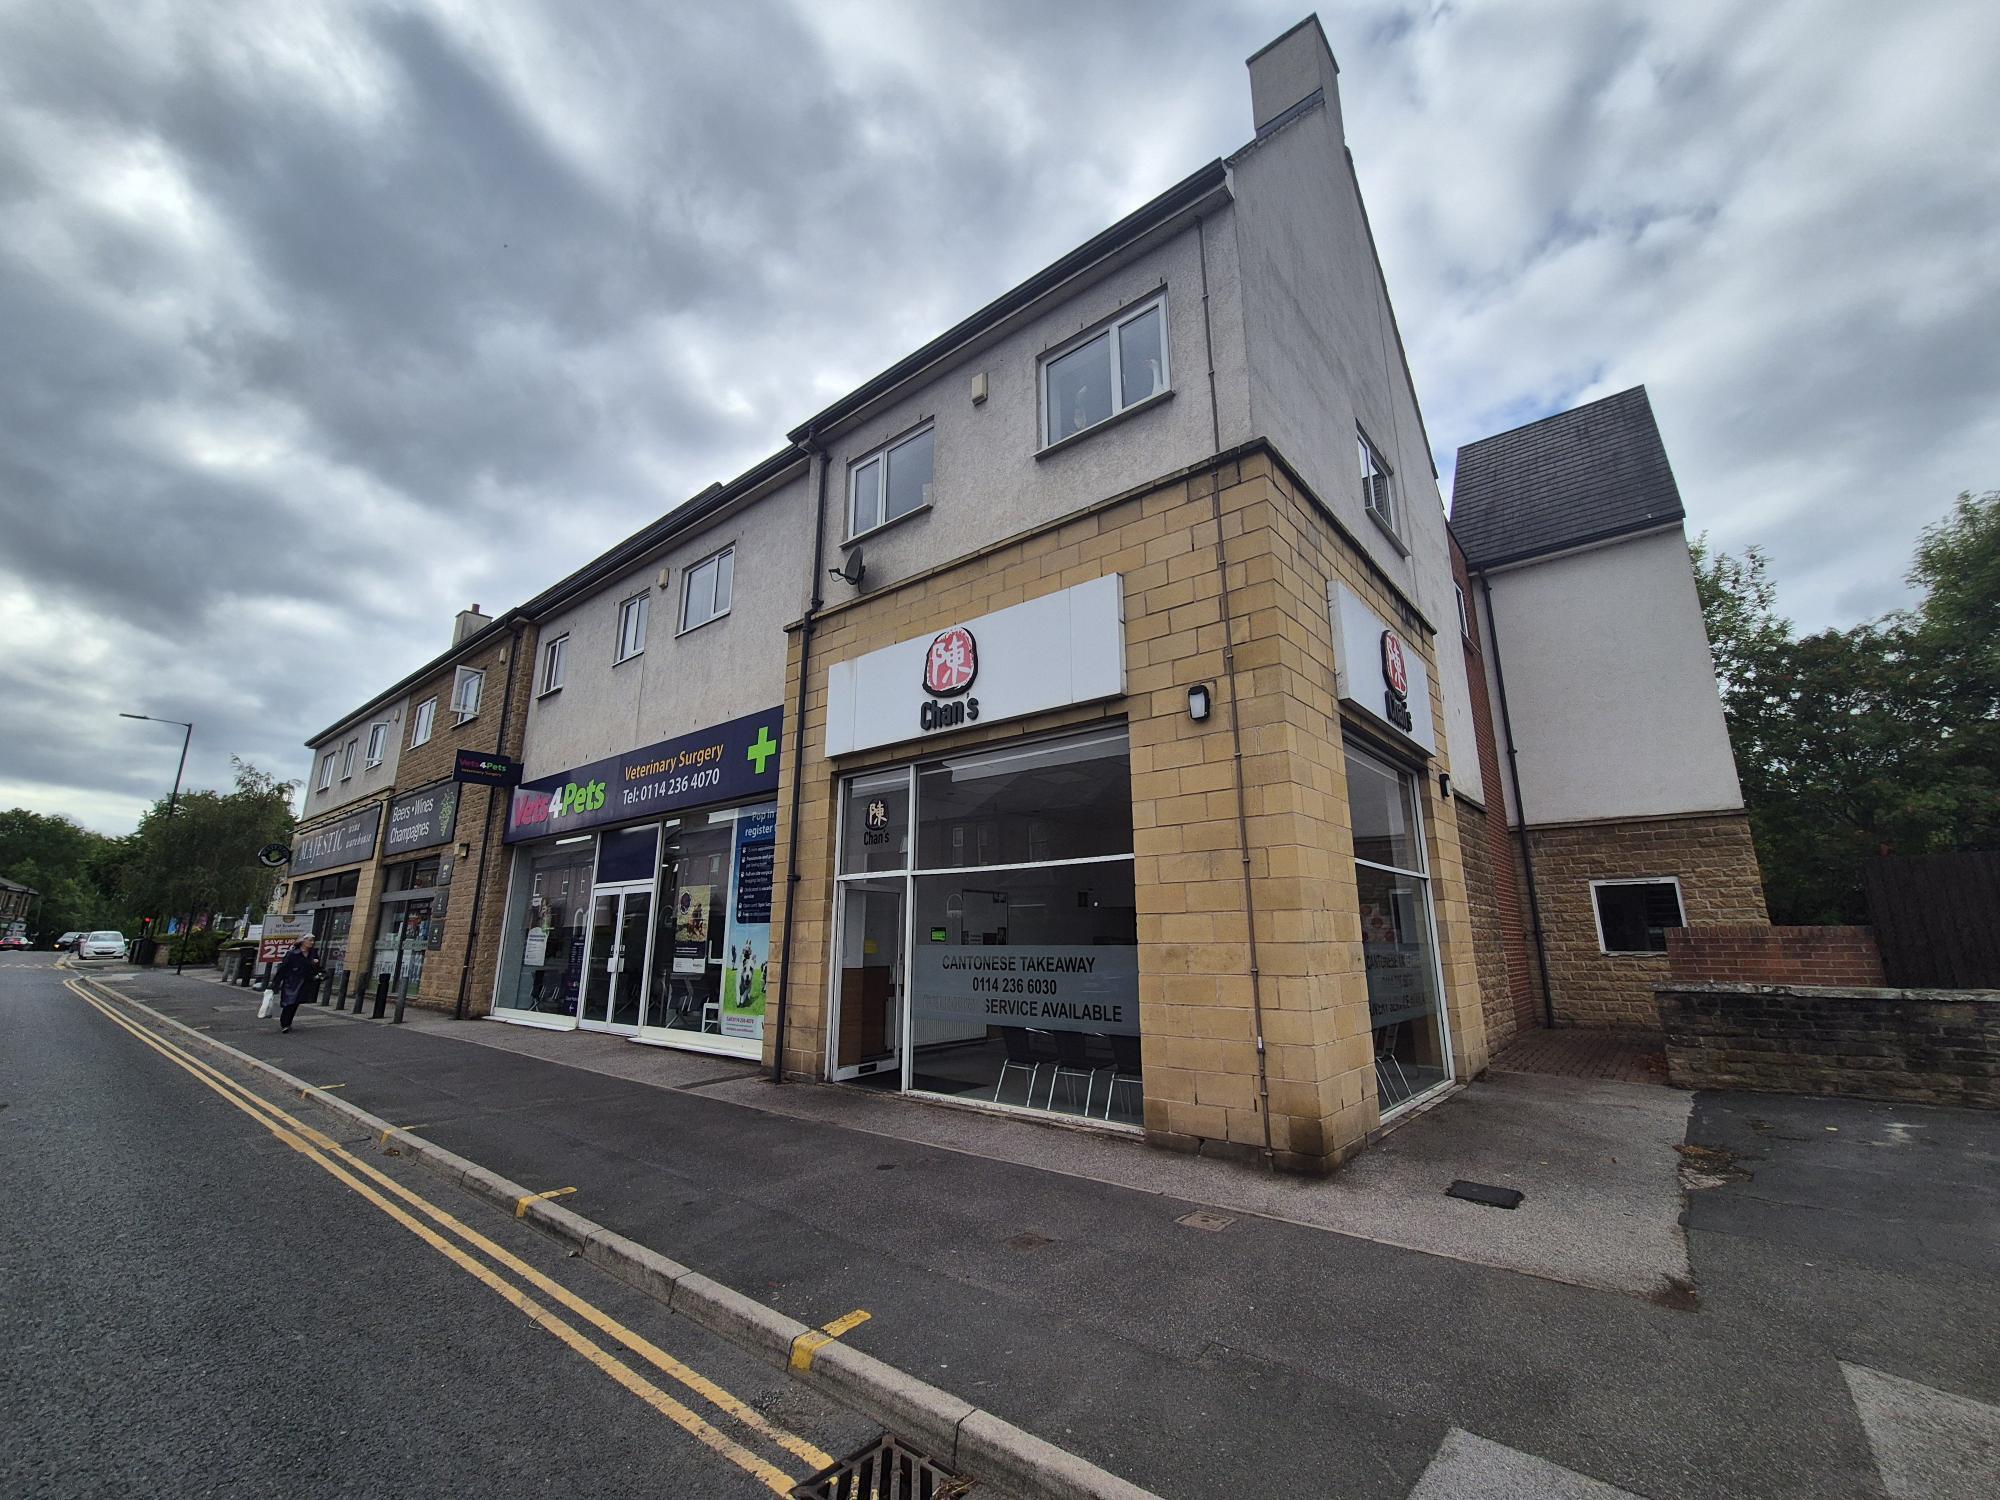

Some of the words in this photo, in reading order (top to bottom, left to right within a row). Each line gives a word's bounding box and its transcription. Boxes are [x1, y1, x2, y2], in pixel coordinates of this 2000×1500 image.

[931, 635, 972, 686] 陳
[920, 692, 980, 731] Chan's
[625, 756, 677, 781] Veterinary
[679, 743, 724, 768] Surgery
[623, 787, 639, 805] Tel:
[641, 780, 665, 801] 0114
[667, 774, 689, 796] 236
[690, 768, 720, 791] 4070
[392, 806, 410, 823] Beers
[414, 797, 434, 815] Wines
[514, 777, 607, 827] Vets4Pets
[390, 821, 430, 844] Champagnes
[745, 824, 772, 838] register
[863, 829, 890, 846] Chan's
[298, 828, 346, 864] MAJESTIC
[942, 955, 1017, 971] CANTONESE
[1019, 957, 1096, 973] TAKEAWAY
[972, 977, 999, 993] 0114
[1002, 978, 1024, 993] 236
[1027, 979, 1057, 995] 6030
[985, 997, 1038, 1017] SERVICE
[1041, 1001, 1123, 1023] AVAILABLE
